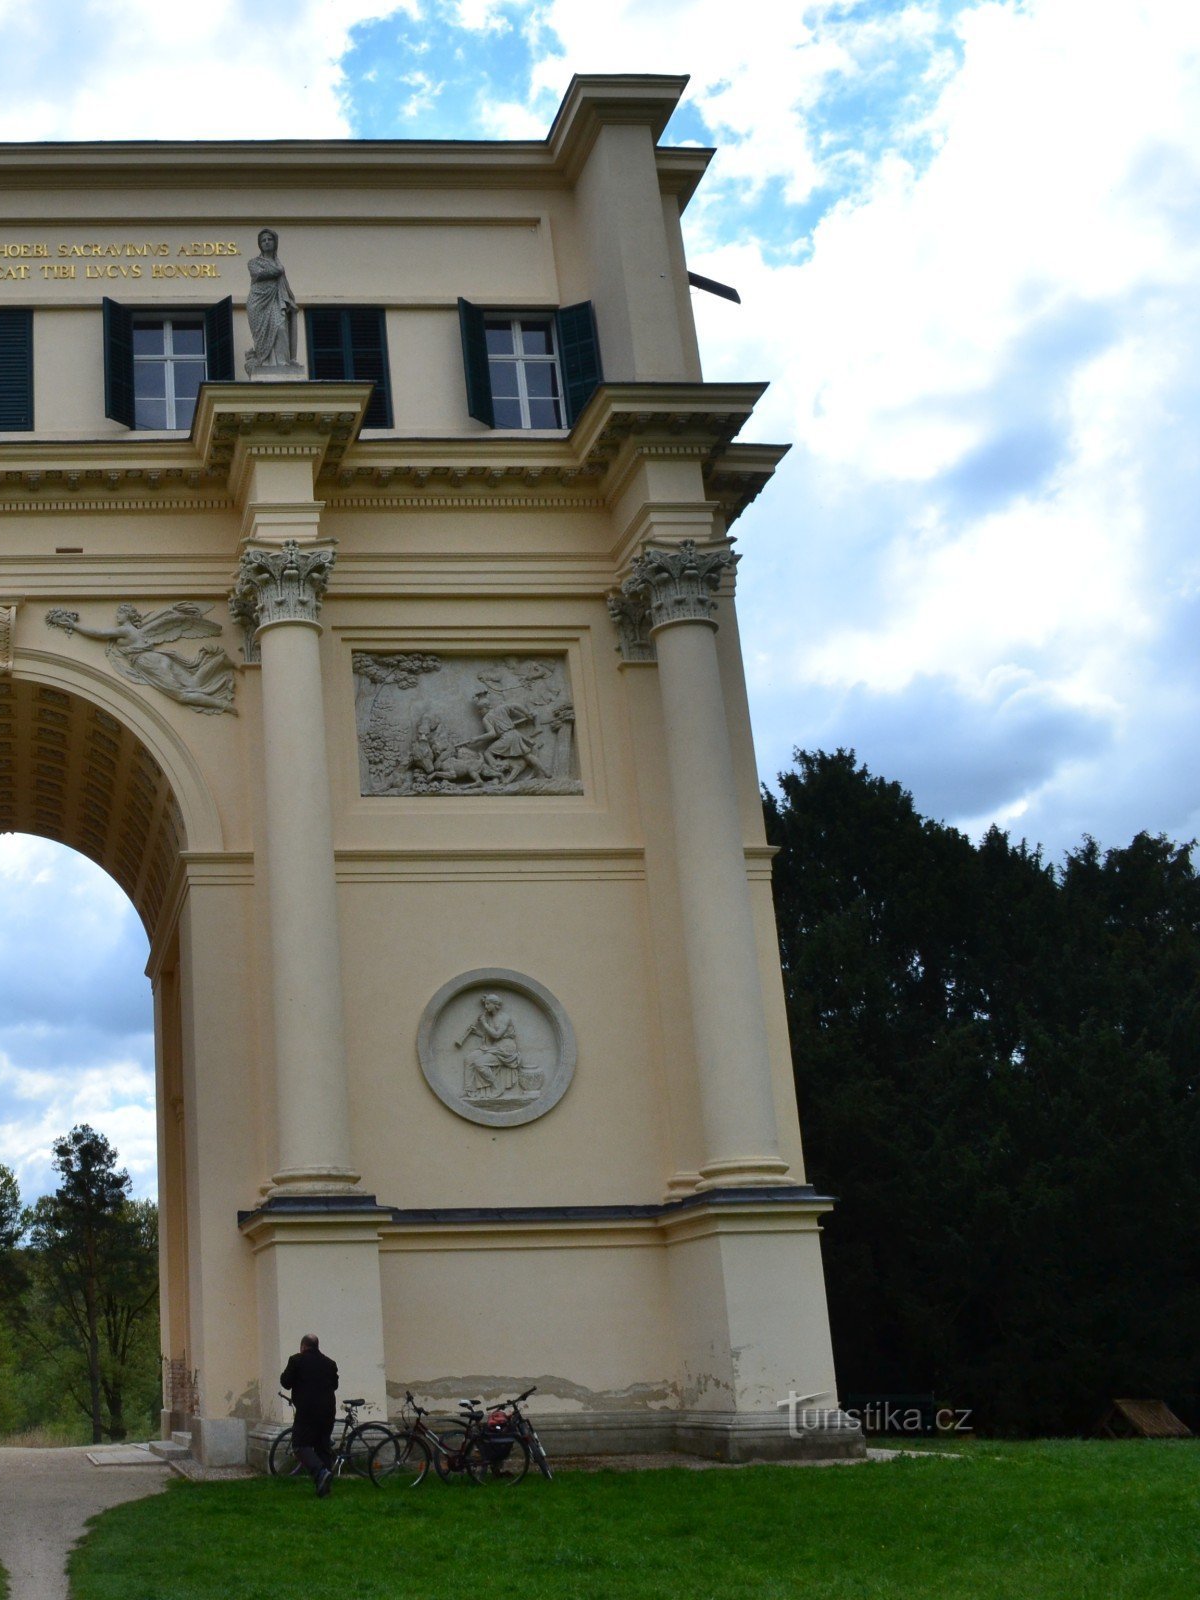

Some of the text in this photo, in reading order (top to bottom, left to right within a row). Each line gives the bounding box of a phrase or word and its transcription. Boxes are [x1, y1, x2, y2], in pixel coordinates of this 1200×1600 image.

[57, 243, 169, 257] SACRAVIMVS
[40, 265, 76, 279] TIBI
[86, 264, 142, 278] LVCVS
